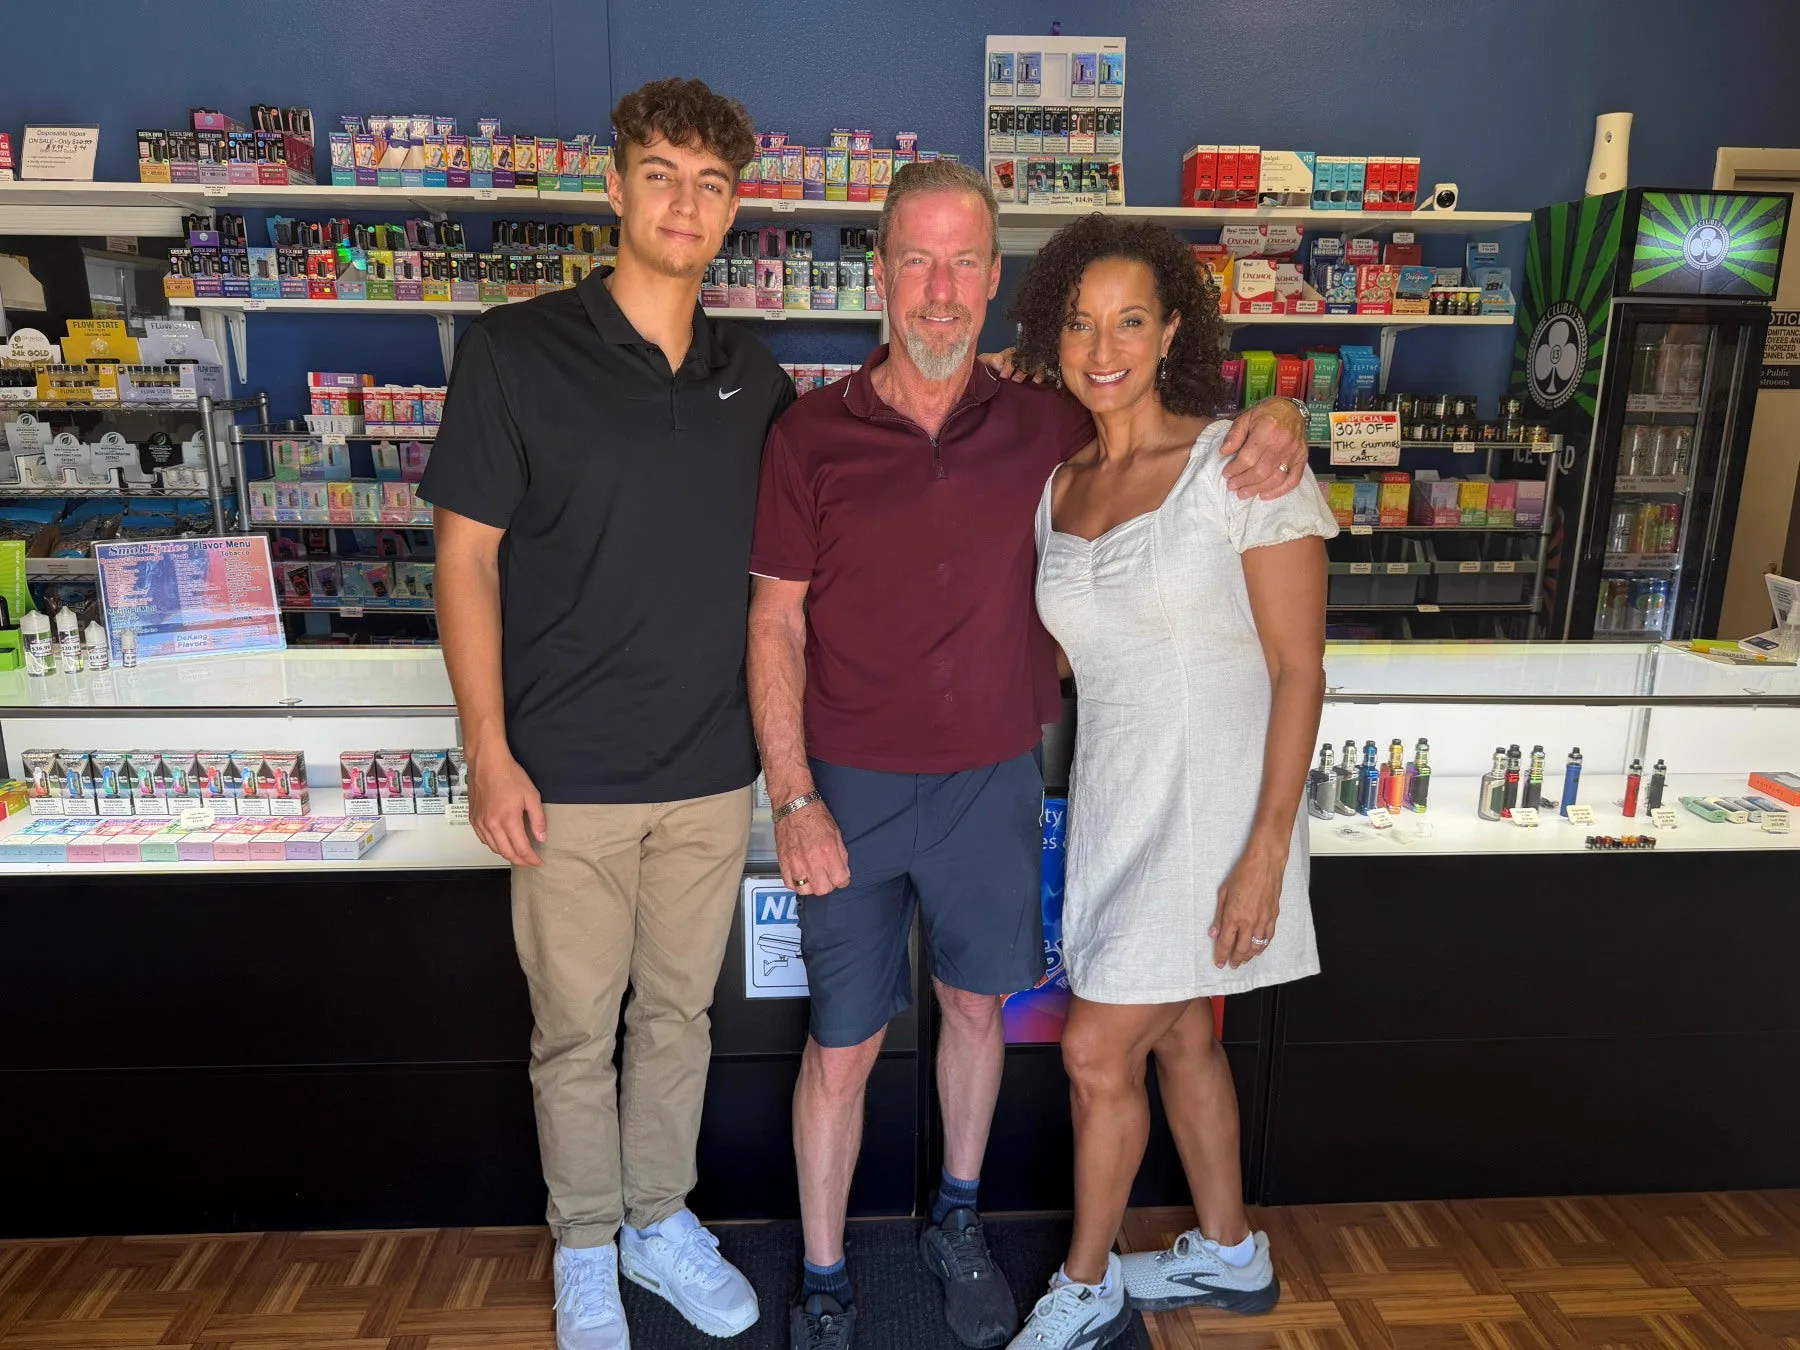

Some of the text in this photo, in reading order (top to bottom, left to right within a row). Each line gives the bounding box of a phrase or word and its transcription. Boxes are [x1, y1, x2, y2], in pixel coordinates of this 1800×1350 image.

[1547, 303, 1578, 319] CLUB13
[1767, 369, 1790, 377] Public
[1335, 423, 1394, 436] 30% OFF
[1334, 441, 1356, 450] THC
[1350, 455, 1378, 463] CARTS
[193, 542, 223, 550] Flavor
